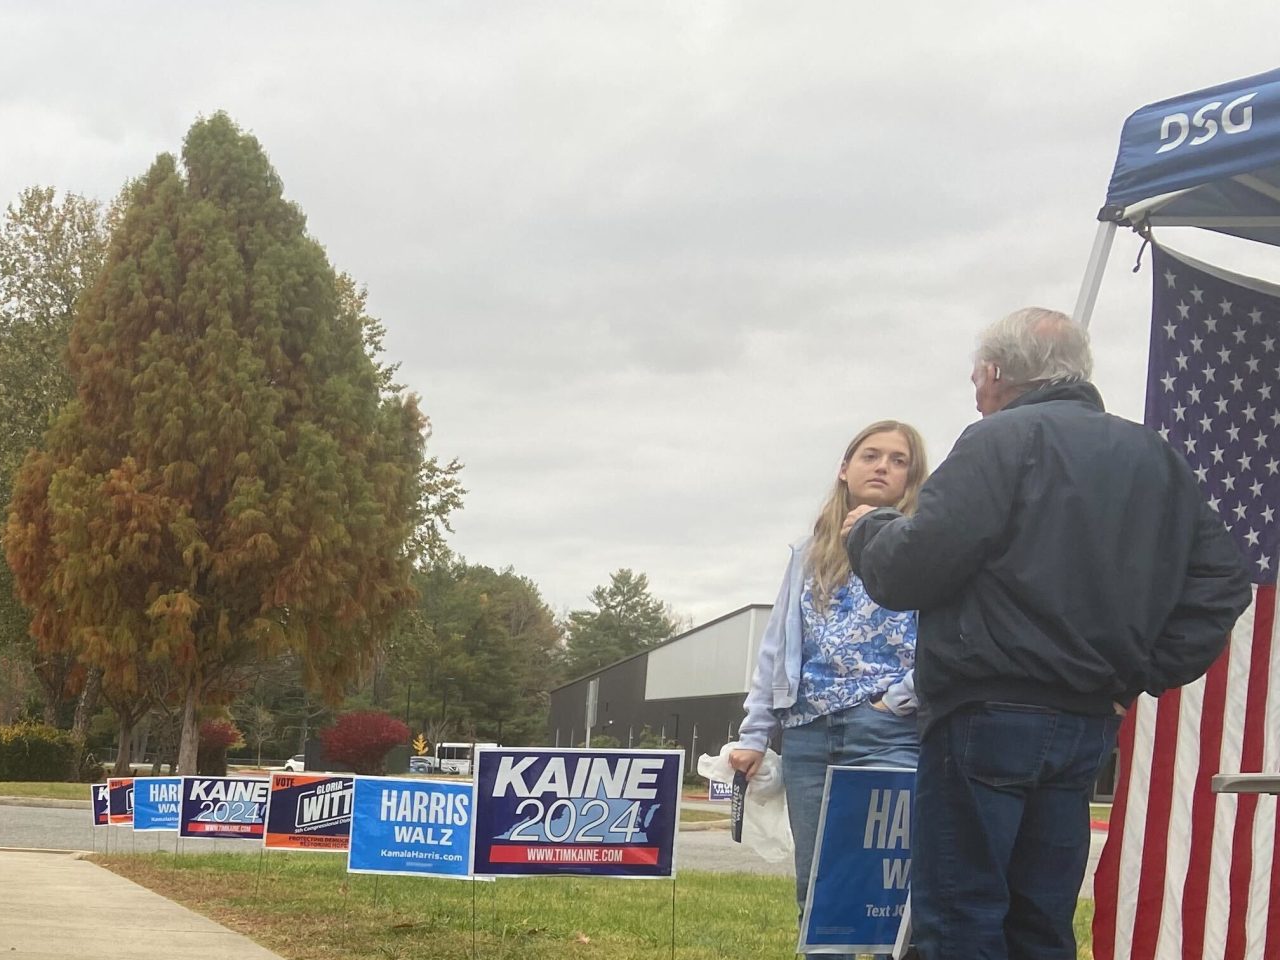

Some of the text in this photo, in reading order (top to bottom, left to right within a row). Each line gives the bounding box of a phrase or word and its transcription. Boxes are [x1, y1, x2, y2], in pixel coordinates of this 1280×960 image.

[1155, 91, 1258, 154] DSG
[276, 777, 294, 787] VOTE
[316, 781, 343, 795] GLORIA
[492, 756, 664, 800] KAINE
[189, 780, 269, 802] KAINE
[197, 801, 260, 823] 2024
[303, 788, 353, 823] WITT
[381, 789, 469, 826] HARRIS
[509, 799, 641, 843] 2024
[394, 826, 453, 846] WALZ
[381, 849, 463, 861] KamalaHarris.com
[527, 848, 623, 862] WWW.TIMKAINE.COM
[866, 904, 890, 917] Text
